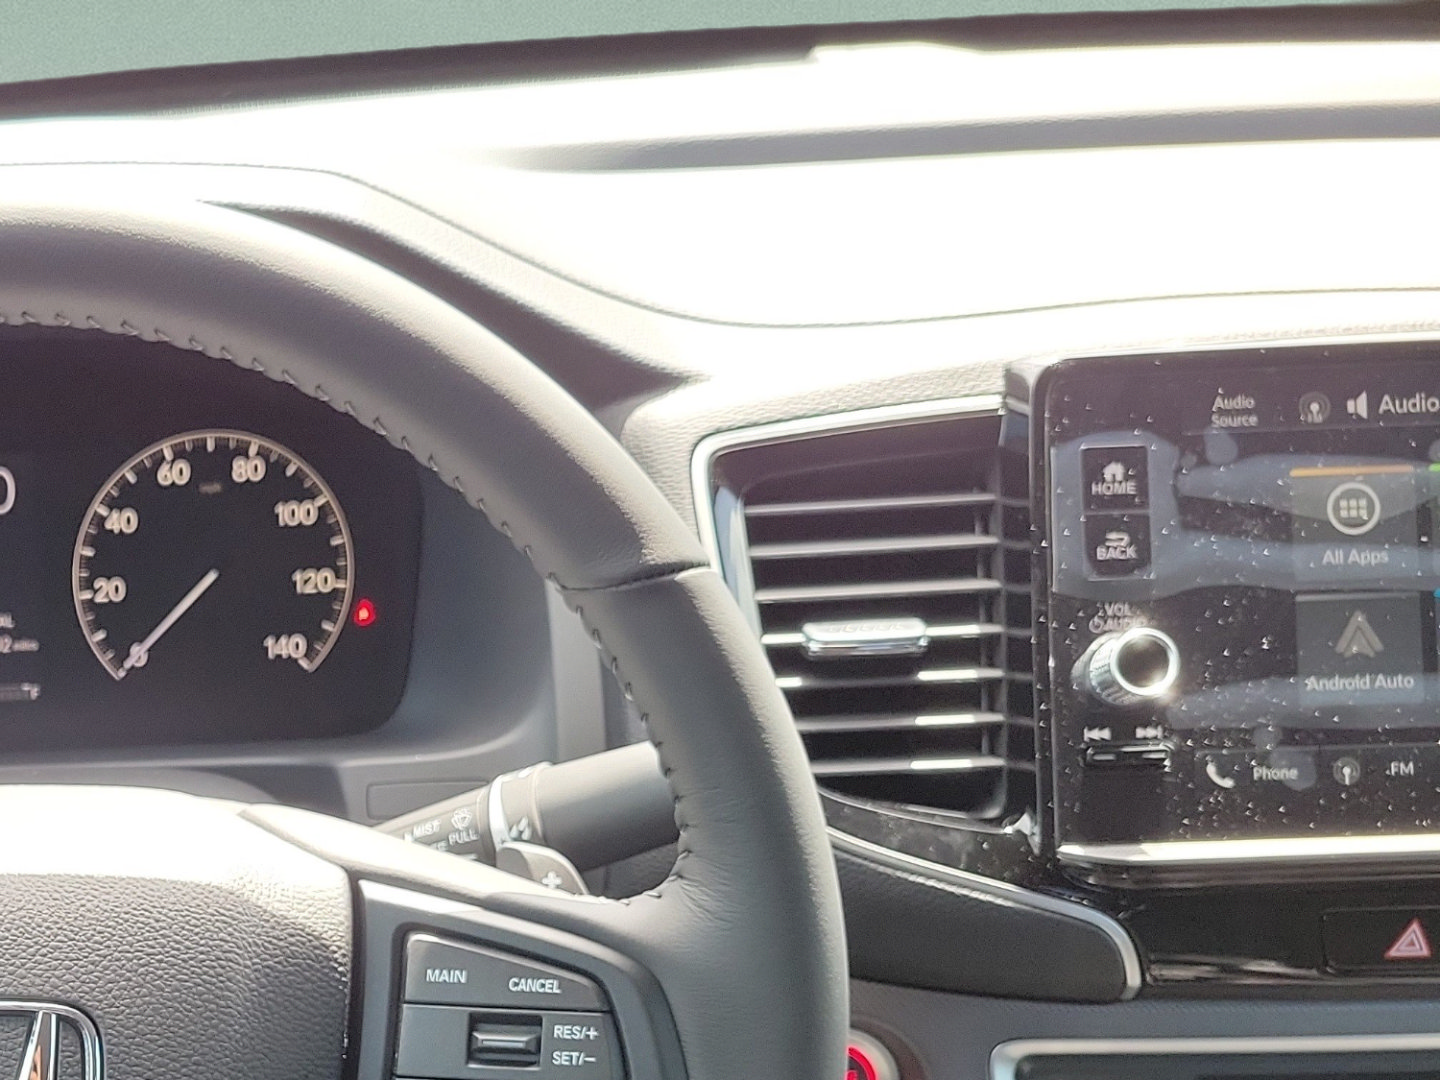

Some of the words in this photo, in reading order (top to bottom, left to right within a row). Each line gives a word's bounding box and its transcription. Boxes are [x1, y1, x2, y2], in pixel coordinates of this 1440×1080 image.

[1212, 394, 1256, 411] Audio
[1378, 391, 1440, 414] Audio
[1211, 413, 1258, 428] Source
[157, 458, 191, 486] 60
[231, 455, 266, 482] 80
[1091, 481, 1137, 496] HOME
[104, 507, 138, 534] 40
[274, 499, 319, 527] 100
[1096, 545, 1138, 561] BACK
[1322, 549, 1348, 565] All
[1350, 550, 1389, 567] Apps
[93, 575, 126, 603] 20
[292, 567, 336, 594] 120
[1103, 601, 1133, 616] VOL
[263, 632, 308, 660] 140
[1309, 674, 1371, 690] Android
[1374, 673, 1415, 690] Auto
[1253, 766, 1298, 782] Phone
[1390, 761, 1414, 777] FM
[426, 968, 467, 984] MAIN
[509, 977, 562, 994] CANCEL
[553, 1025, 599, 1041] RES/+
